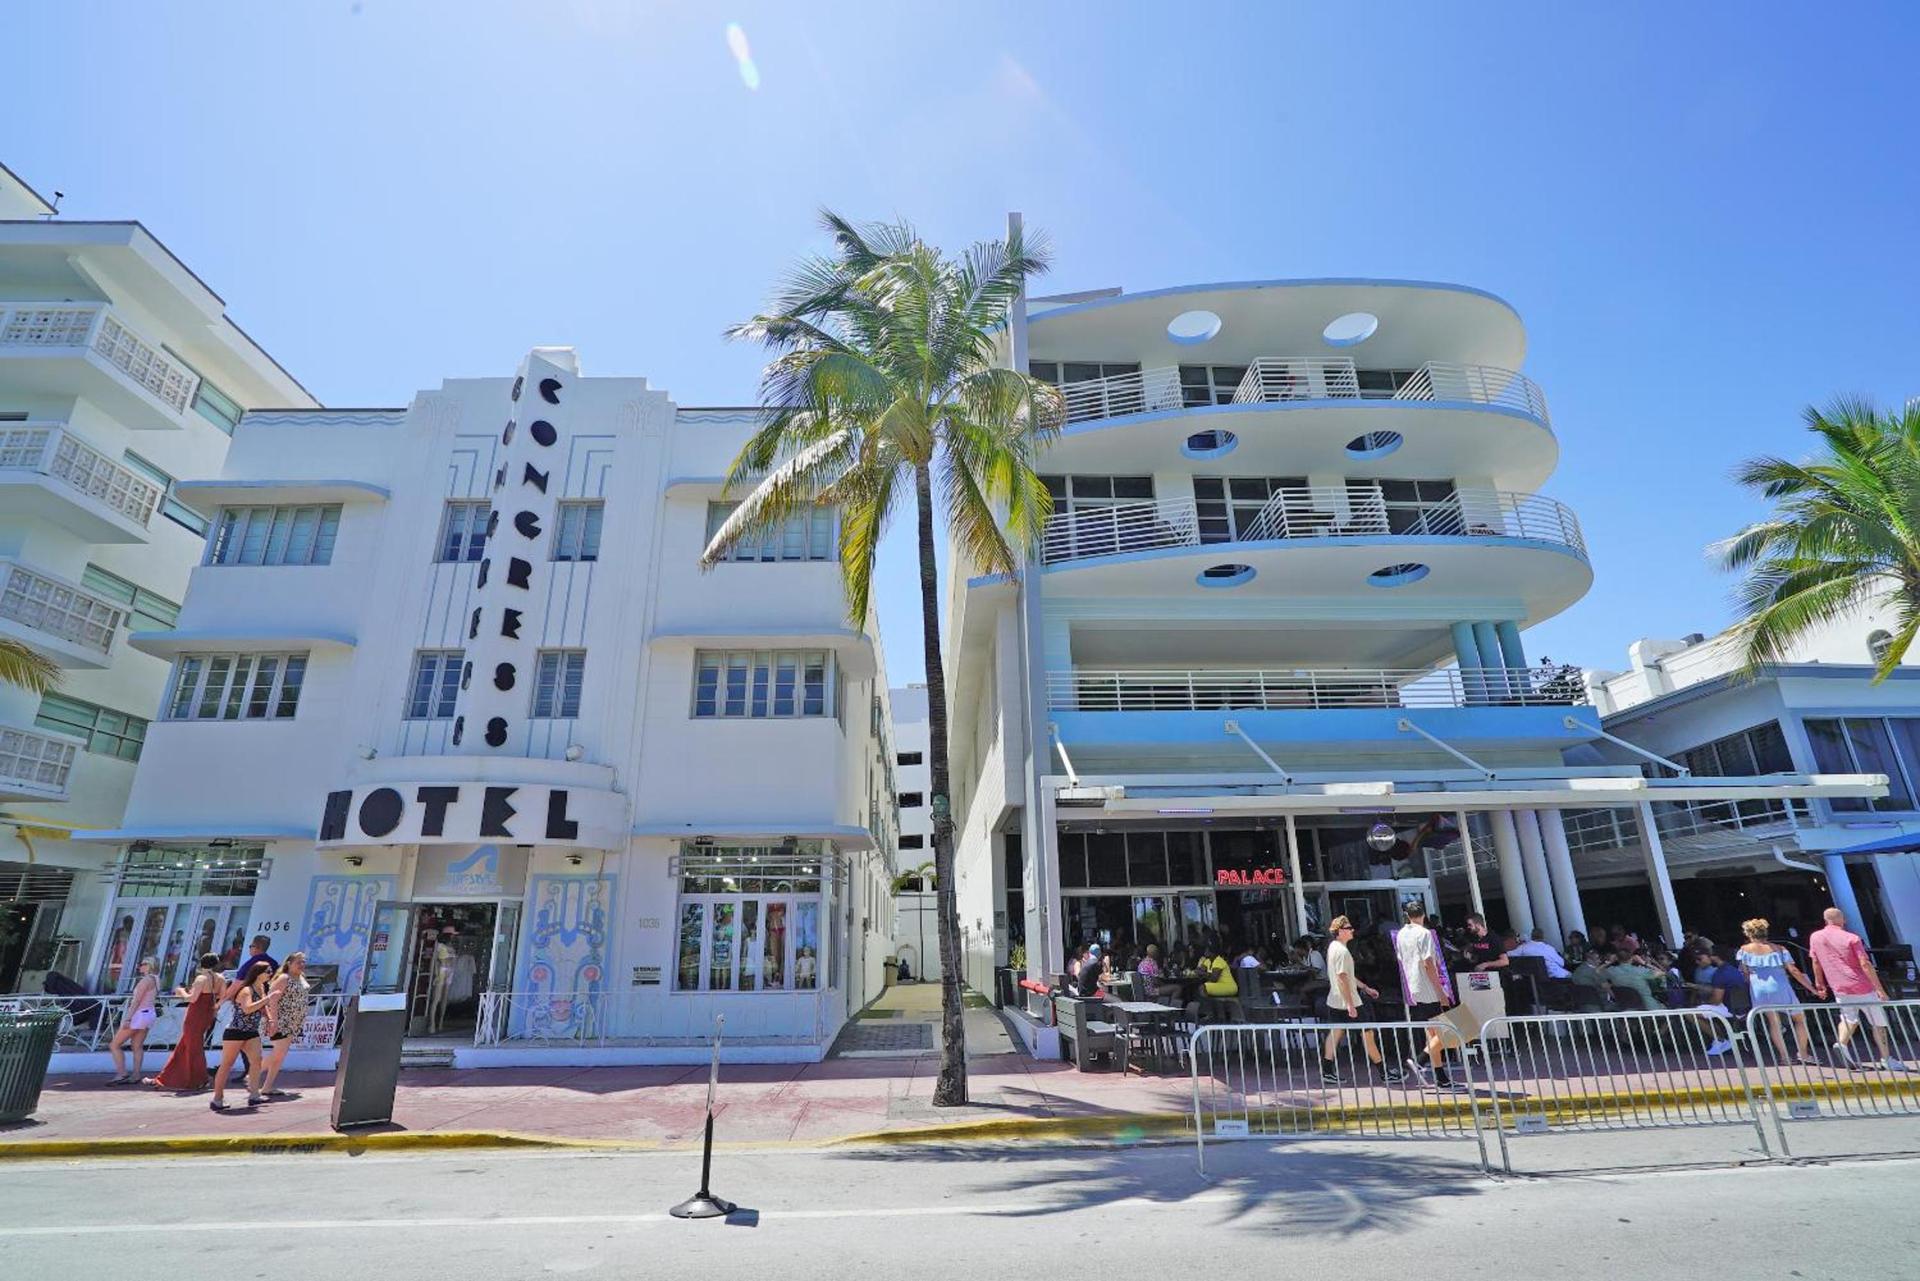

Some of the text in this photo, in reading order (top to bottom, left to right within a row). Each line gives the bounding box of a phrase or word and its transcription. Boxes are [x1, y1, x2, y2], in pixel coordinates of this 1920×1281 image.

[484, 378, 562, 747] CONGRESS
[319, 785, 579, 840] HOTEL
[1217, 868, 1284, 885] PALACE
[257, 921, 290, 931] 1036
